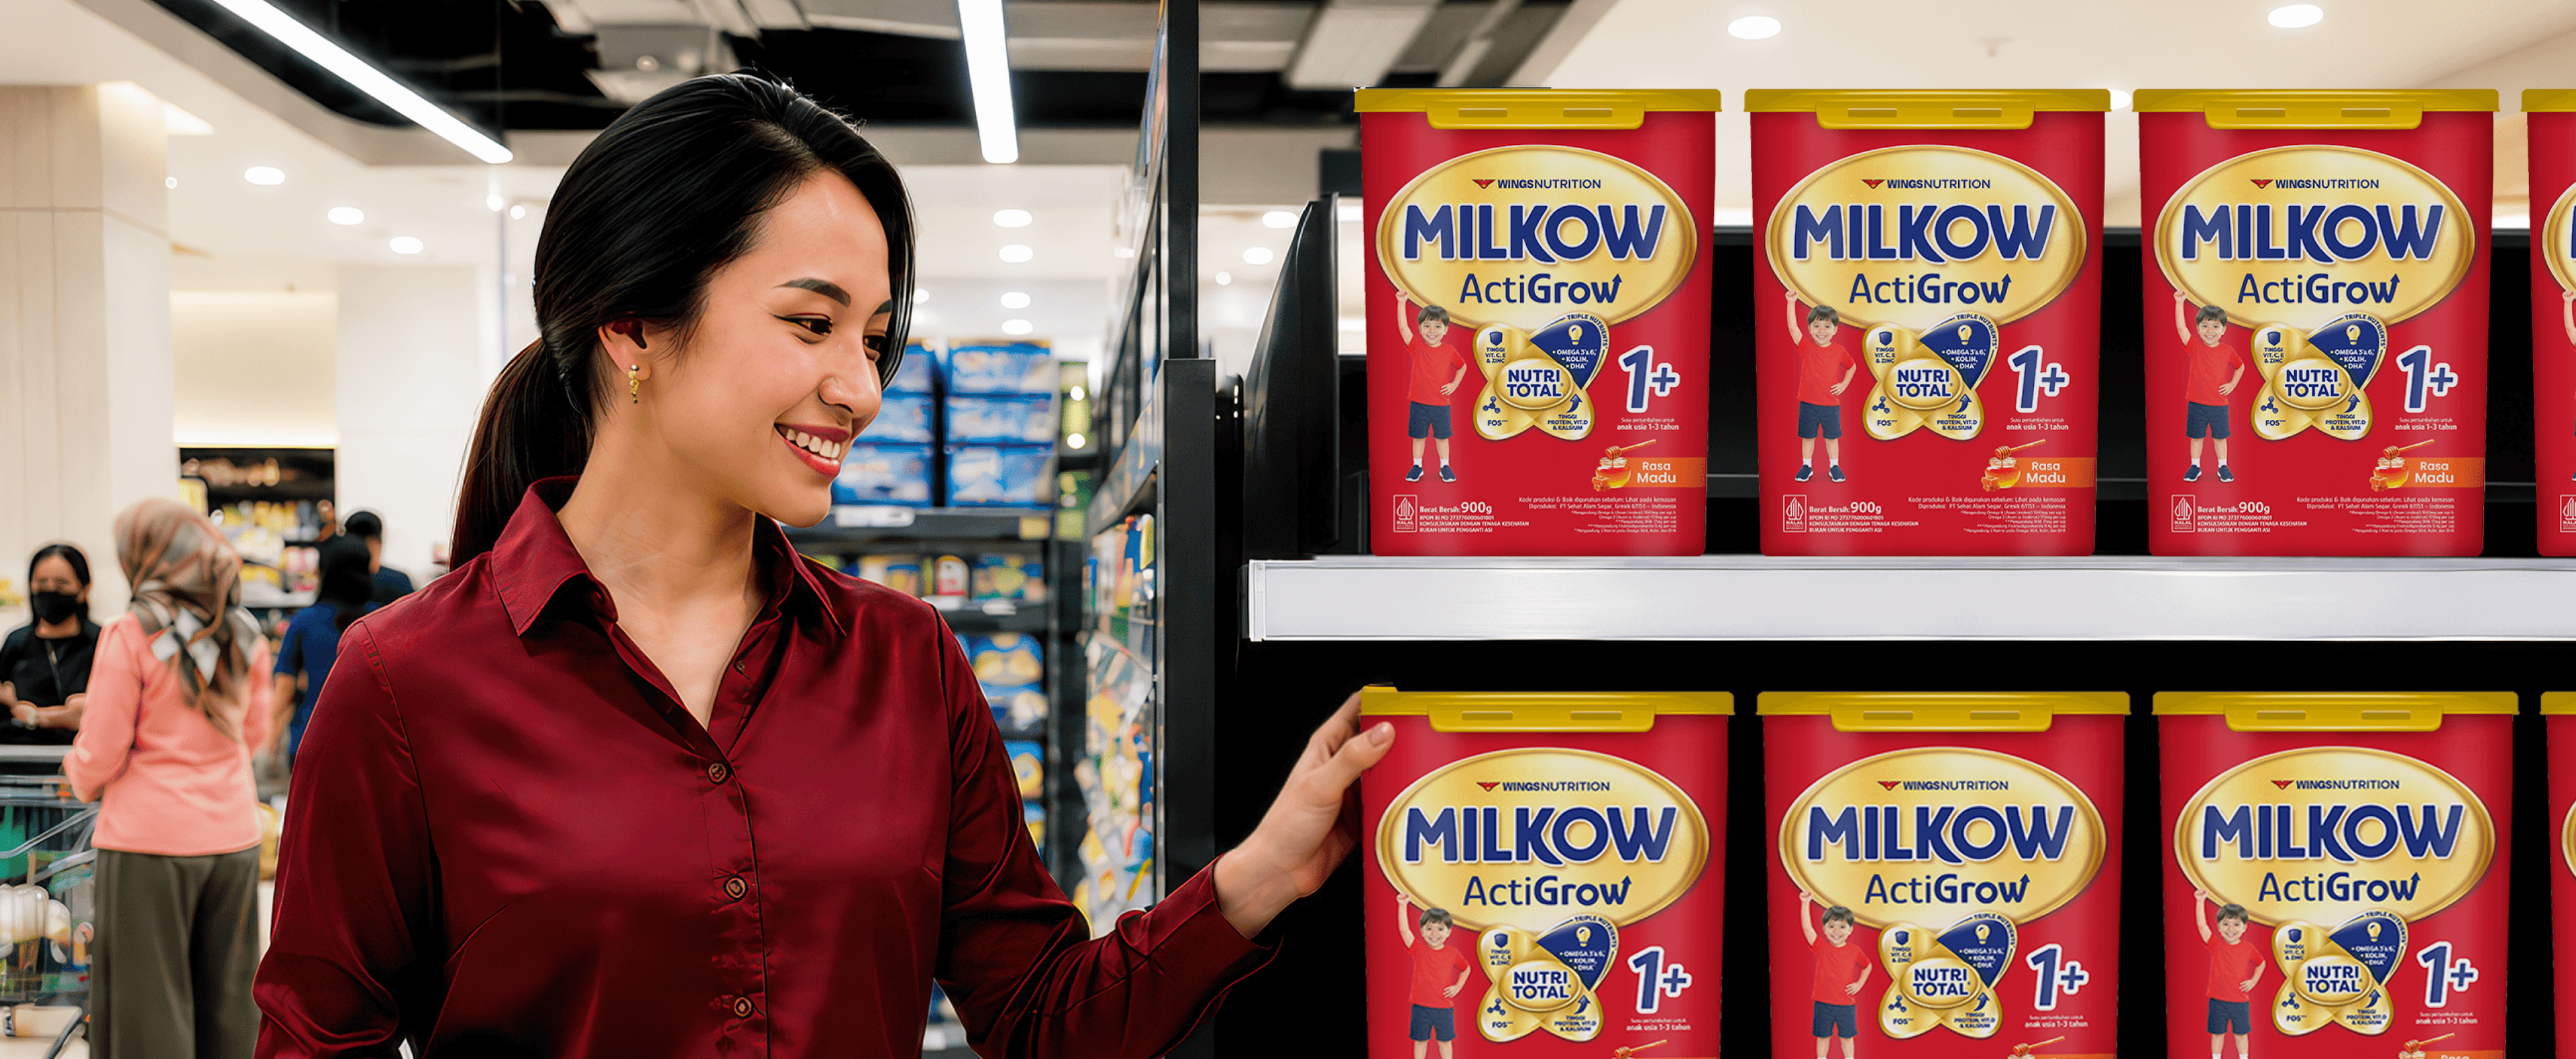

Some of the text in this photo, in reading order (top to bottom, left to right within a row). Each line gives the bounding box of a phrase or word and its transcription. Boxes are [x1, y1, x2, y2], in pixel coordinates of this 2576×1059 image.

[1497, 179, 1601, 189] WINGSNUTRITION
[1886, 179, 1990, 189] WINGSNUTRITION
[2275, 179, 2379, 189] WINGSNUTRITION
[1403, 204, 1666, 264] MILKOW
[1792, 204, 2055, 264] MILKOW
[2182, 204, 2444, 264] MILKOW
[1460, 273, 1623, 304] ActiGrow
[1849, 273, 2012, 304] ActiGrow
[2238, 273, 2401, 304] ActiGrow
[1507, 369, 1560, 383] NUTRI
[1619, 345, 1680, 412] 1+
[1897, 369, 1949, 383] NUTRI
[2008, 345, 2069, 412] 1+
[2286, 369, 2339, 383] NUTRI
[2397, 345, 2458, 412] 1+
[1637, 471, 1676, 483] Madu
[1642, 461, 1670, 471] Rasa
[2026, 471, 2065, 483] Madu
[2031, 461, 2059, 471] Rasa
[2415, 471, 2454, 483] Madu
[2420, 461, 2449, 471] Rasa
[1460, 501, 1493, 514] 900g
[1850, 501, 1882, 514] 900g
[2239, 501, 2271, 514] 900g
[1405, 807, 1677, 866] MILKOW
[1807, 805, 2074, 864] MILKOW
[2202, 804, 2464, 862] MILKOW
[1463, 875, 1632, 907] ActiGrow
[1865, 873, 2031, 904] ActiGrow
[2259, 872, 2421, 902] ActiGrow
[1513, 970, 1568, 985] NUTRI
[1628, 946, 1692, 1013] 1+
[1913, 968, 1968, 982] NUTRI
[2027, 944, 2089, 1010] 1+
[2306, 965, 2359, 979] NUTRI
[2418, 942, 2479, 1007] 1+
